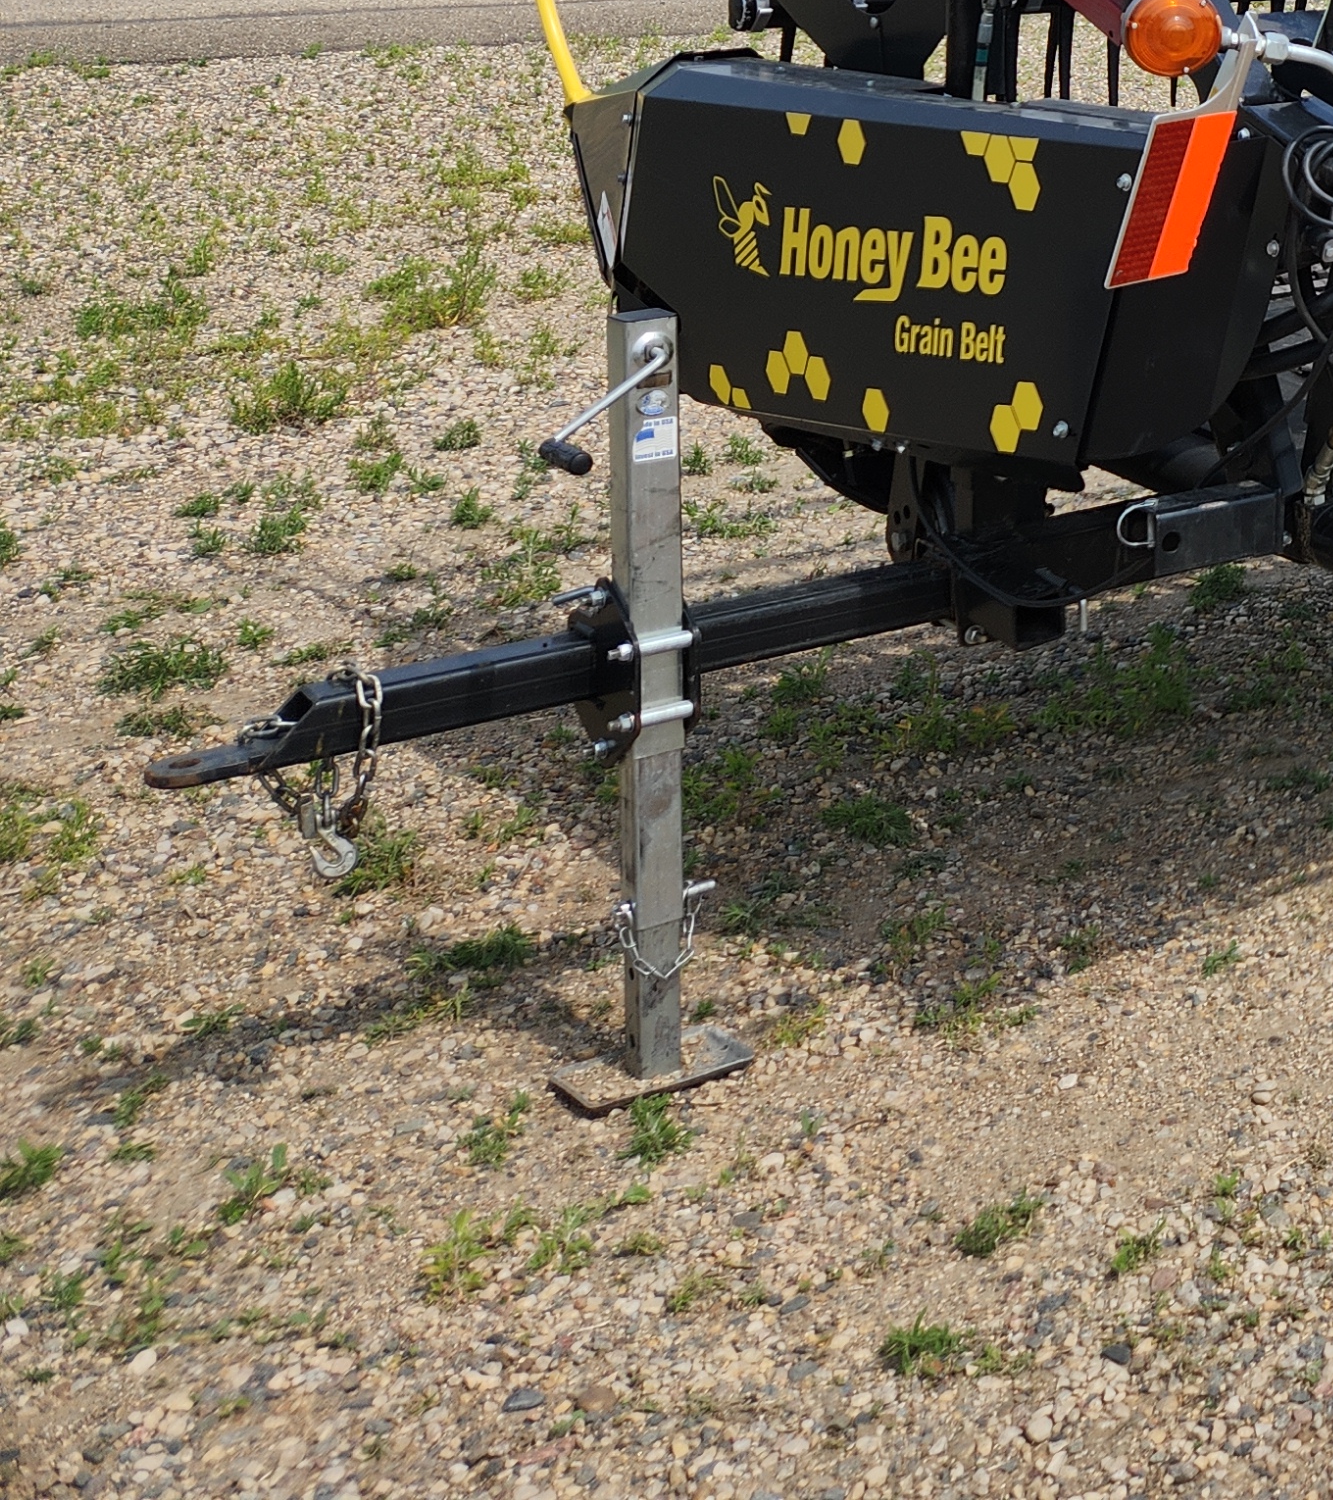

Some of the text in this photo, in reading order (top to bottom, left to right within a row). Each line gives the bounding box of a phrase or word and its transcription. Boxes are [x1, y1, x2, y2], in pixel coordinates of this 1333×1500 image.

[779, 207, 1008, 302] Honey Bee
[894, 315, 1006, 364] Grain Belt
